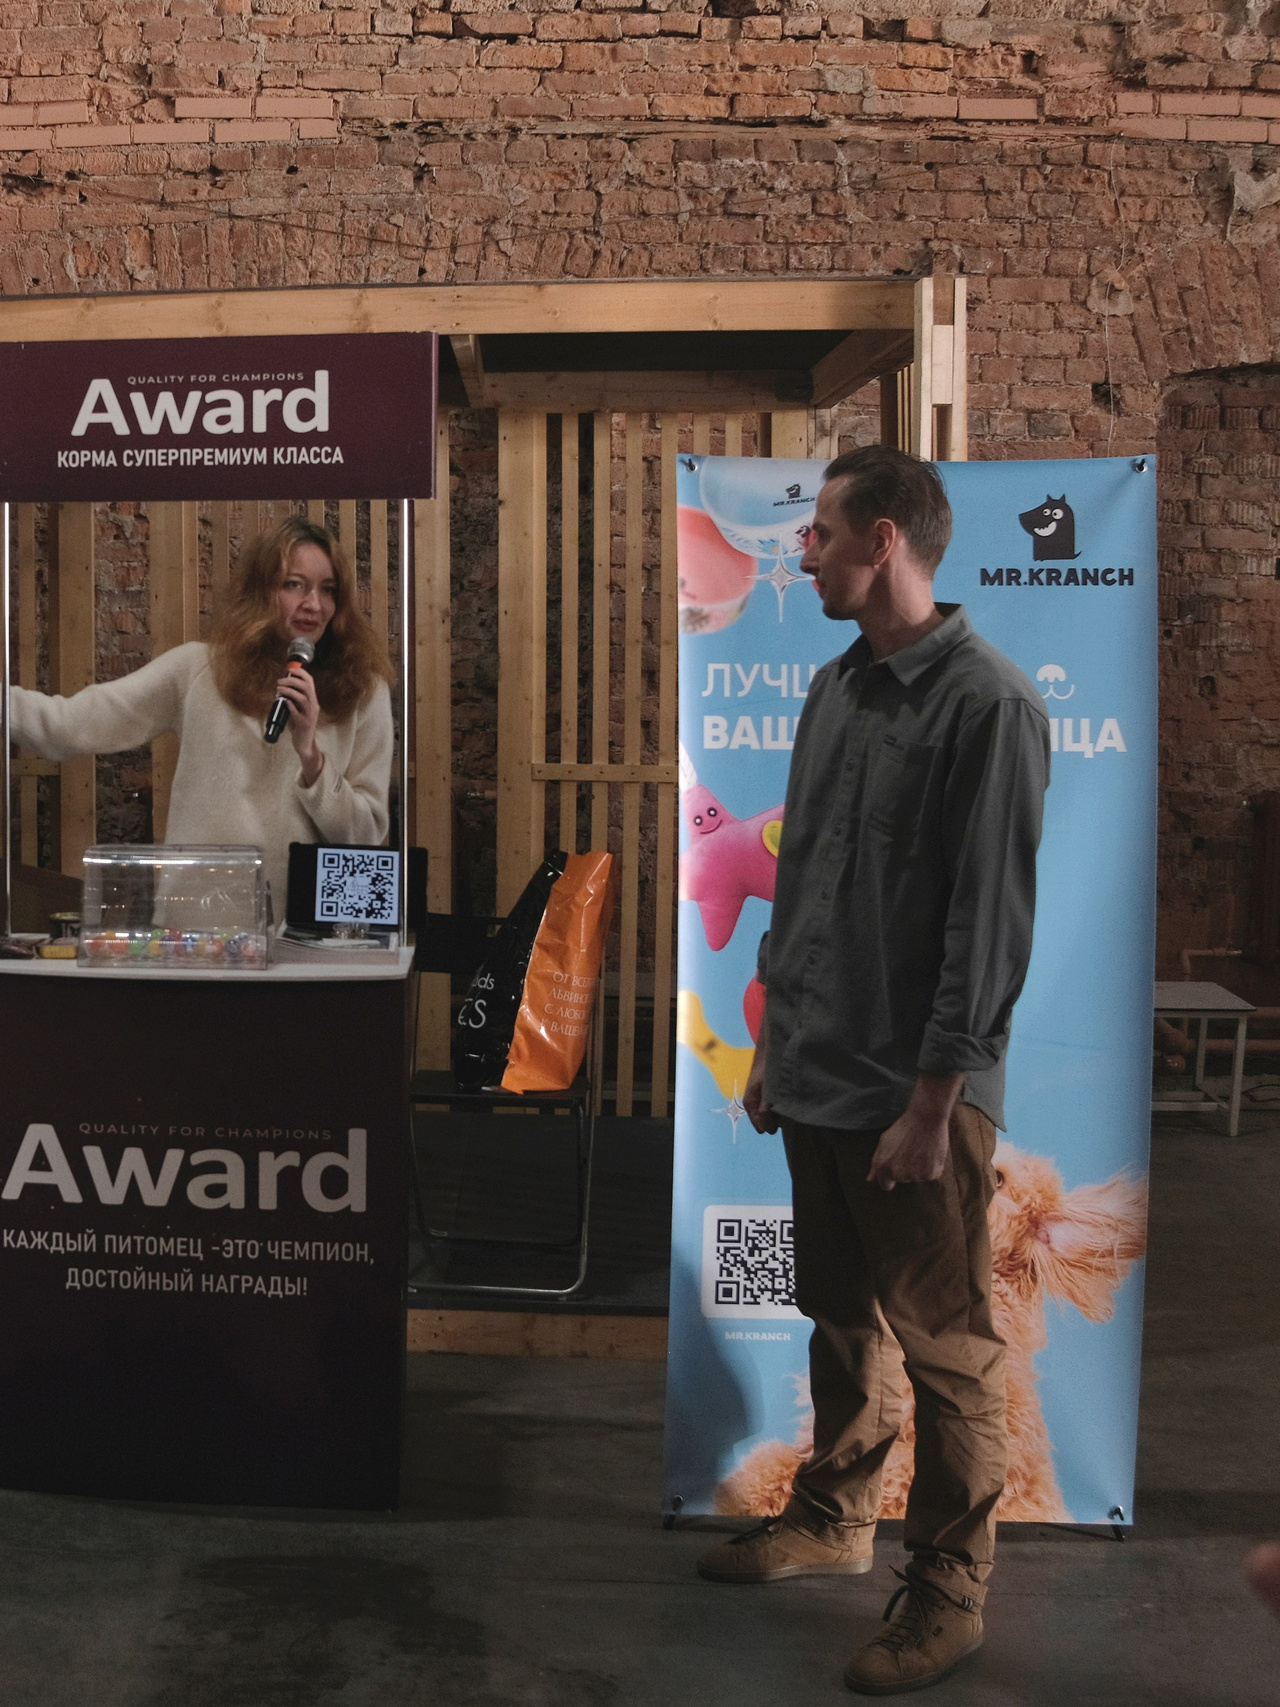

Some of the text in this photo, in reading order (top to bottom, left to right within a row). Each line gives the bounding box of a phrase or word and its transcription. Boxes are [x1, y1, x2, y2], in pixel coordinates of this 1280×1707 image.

[127, 372, 304, 385] QUALITY FOR CHAMPIONS
[71, 369, 329, 437] Award
[57, 445, 344, 468] КОРМА СУПЕРПРЕМИУМ КЛАССА
[980, 568, 1134, 587] MR.KRANCH
[553, 971, 570, 984] ОТ
[544, 1003, 554, 1015] С
[79, 1122, 332, 1140] QUALITY FOR CHAMPIONS
[1, 1123, 367, 1213] Award
[2, 1228, 97, 1255] КАЖДЫЙ
[104, 1235, 204, 1260] ПИТОМЕЦ
[267, 1240, 375, 1266] ЧЕМПИОН,
[66, 1267, 308, 1299] ДОСТОЙНЫЙ НАГРАДЫ!
[725, 1331, 791, 1341] MR.KRANCH
